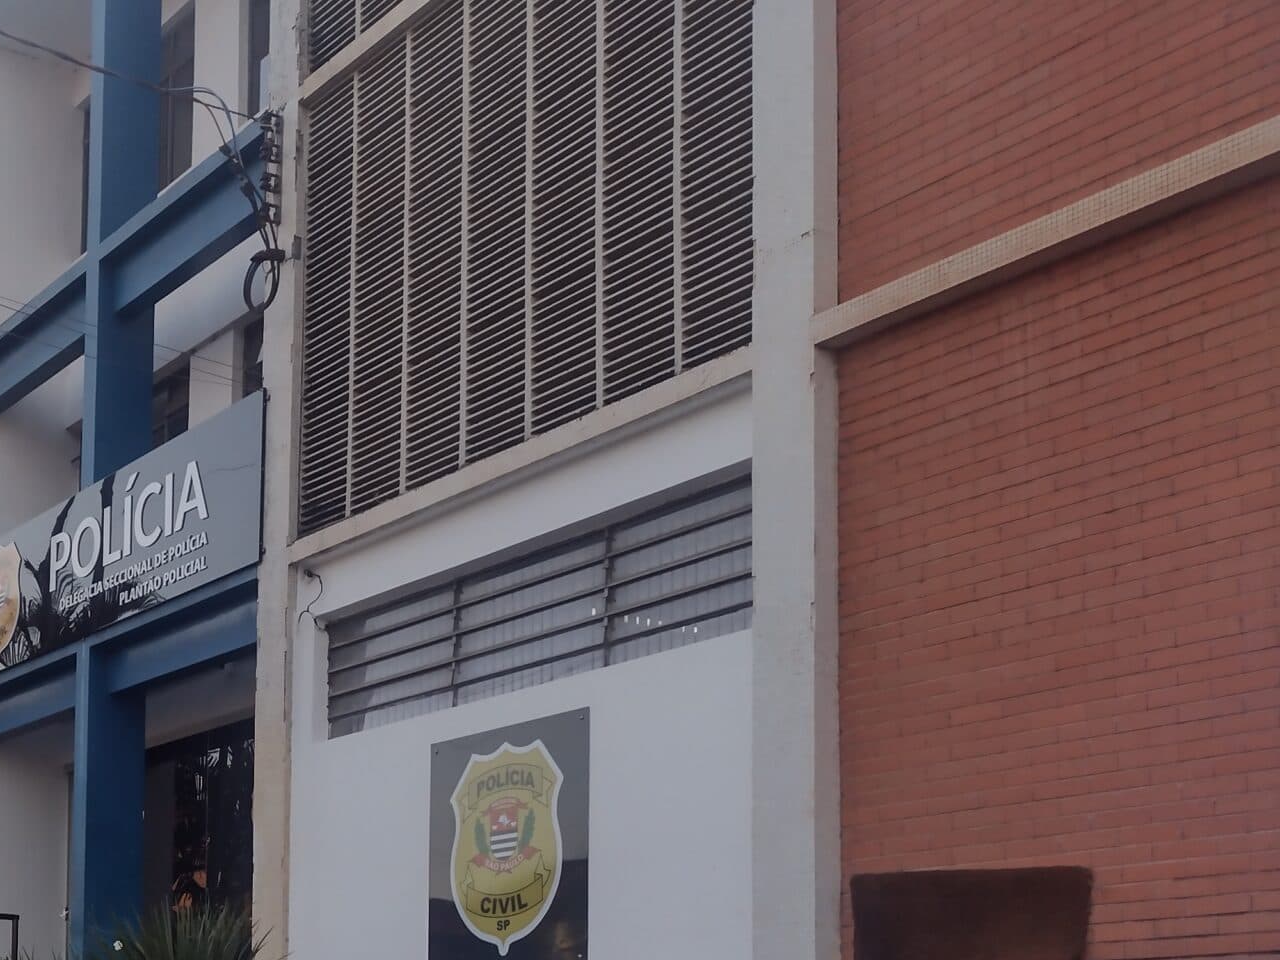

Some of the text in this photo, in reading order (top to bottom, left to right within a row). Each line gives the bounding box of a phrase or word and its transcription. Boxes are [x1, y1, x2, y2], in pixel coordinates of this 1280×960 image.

[49, 460, 209, 592] POLÍCIA
[59, 531, 208, 611] DELEGACIA SECCIONAL DE POLÍCIA
[119, 556, 208, 606] PLANTÃO POLICIAL
[476, 768, 536, 799] POLÍCIA
[480, 893, 529, 915] CIVIL
[496, 919, 511, 932] SP
